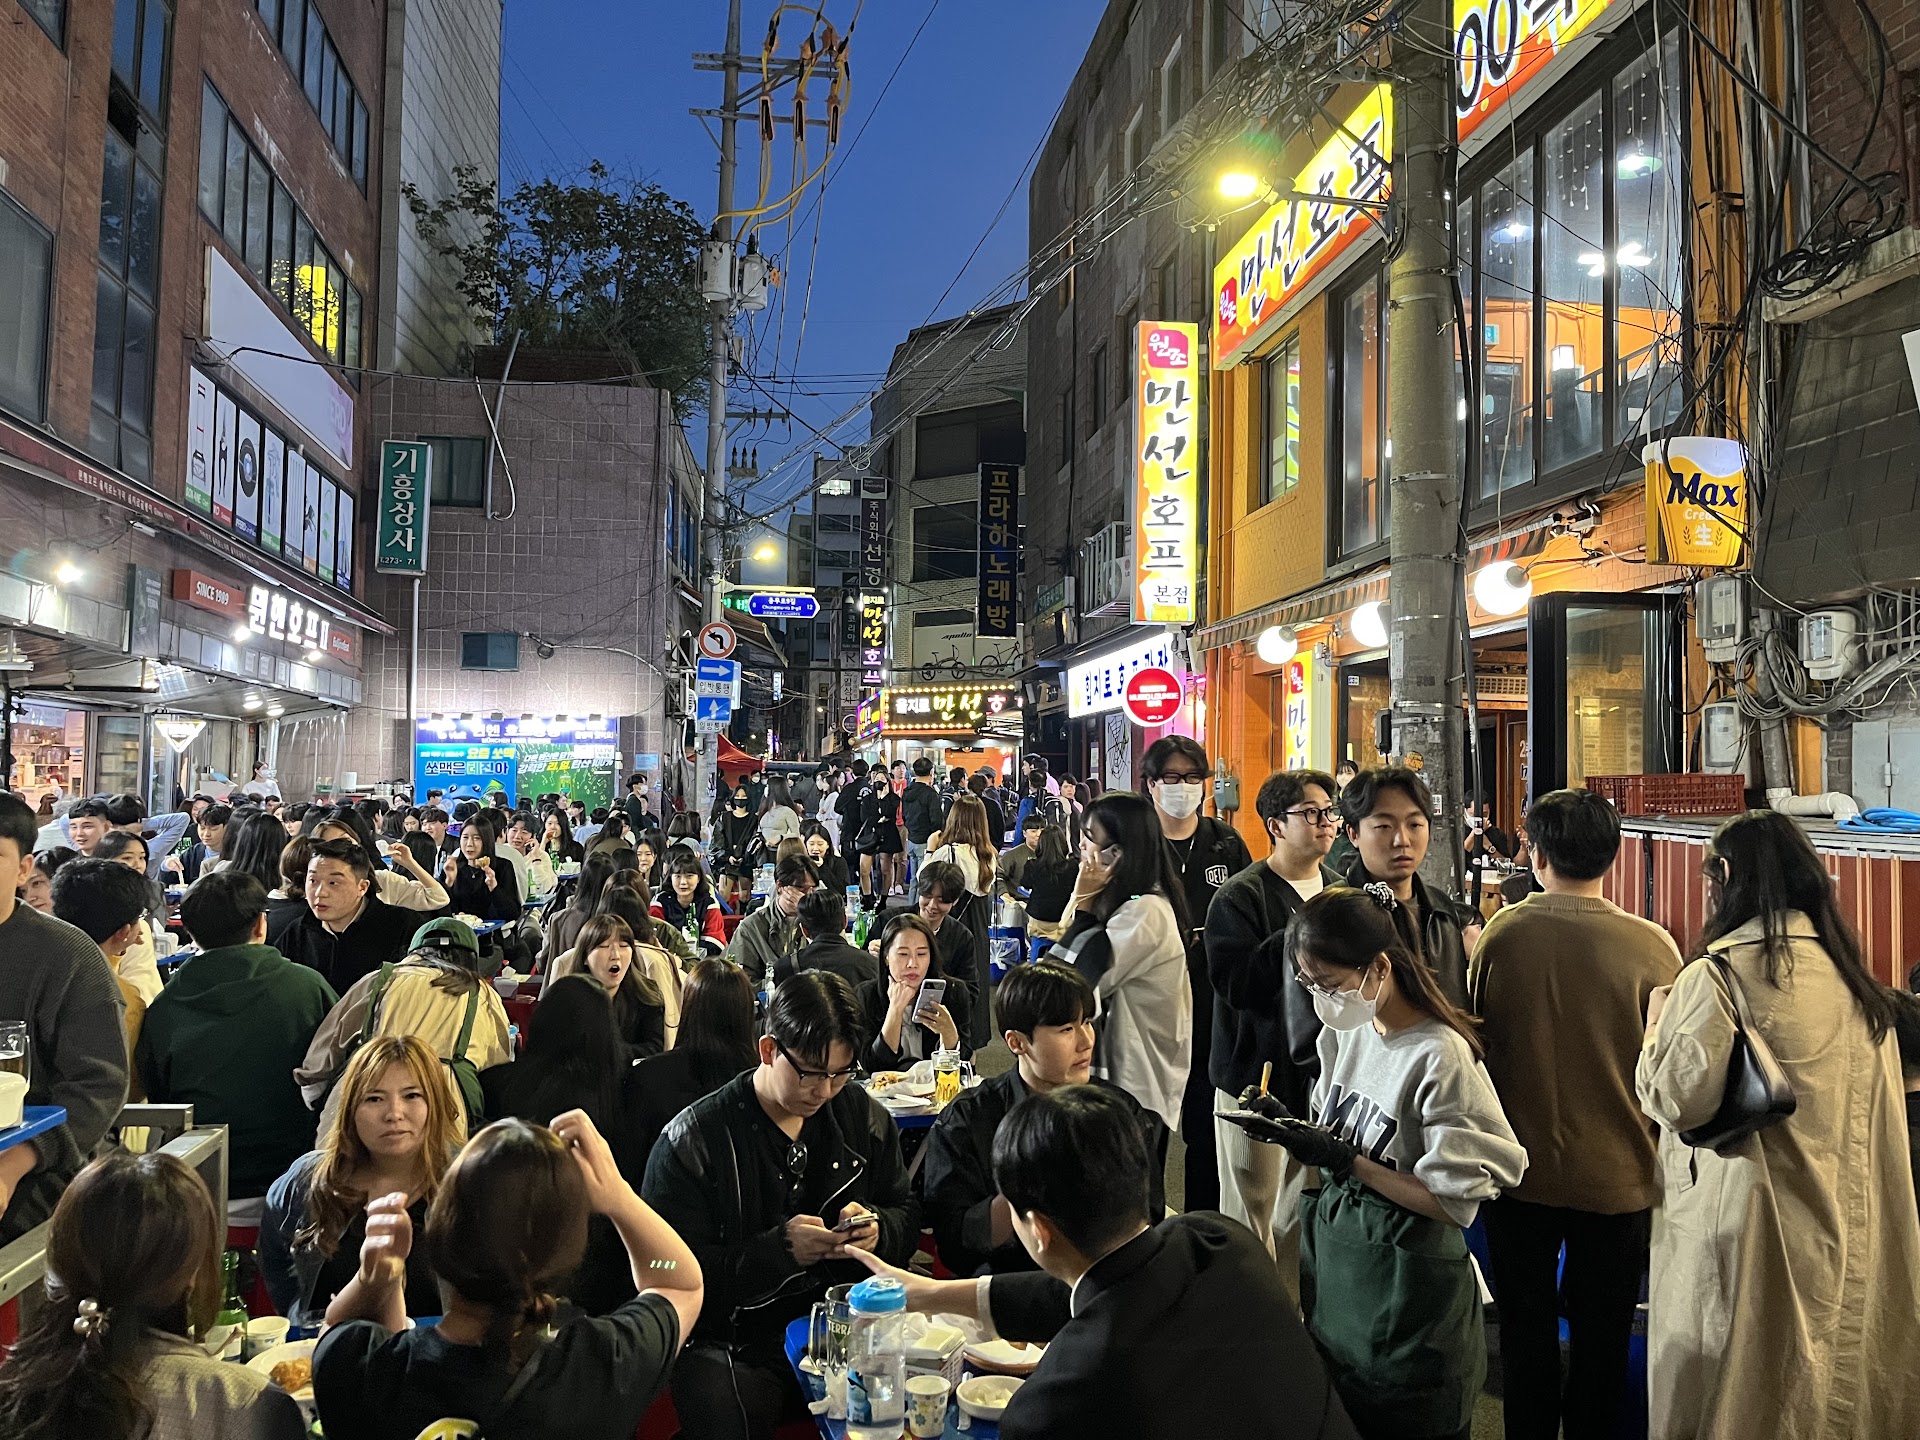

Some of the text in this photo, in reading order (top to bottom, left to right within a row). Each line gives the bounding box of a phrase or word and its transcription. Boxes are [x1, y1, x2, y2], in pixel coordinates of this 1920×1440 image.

[1148, 332, 1187, 367] 원조
[1143, 380, 1191, 568] 만선호프
[385, 448, 418, 552] 기흥상사
[1666, 473, 1741, 507] Max
[1694, 522, 1714, 546] 生
[195, 581, 215, 601] SINCE
[1153, 585, 1188, 605] 본점
[700, 682, 731, 695] 일방통행
